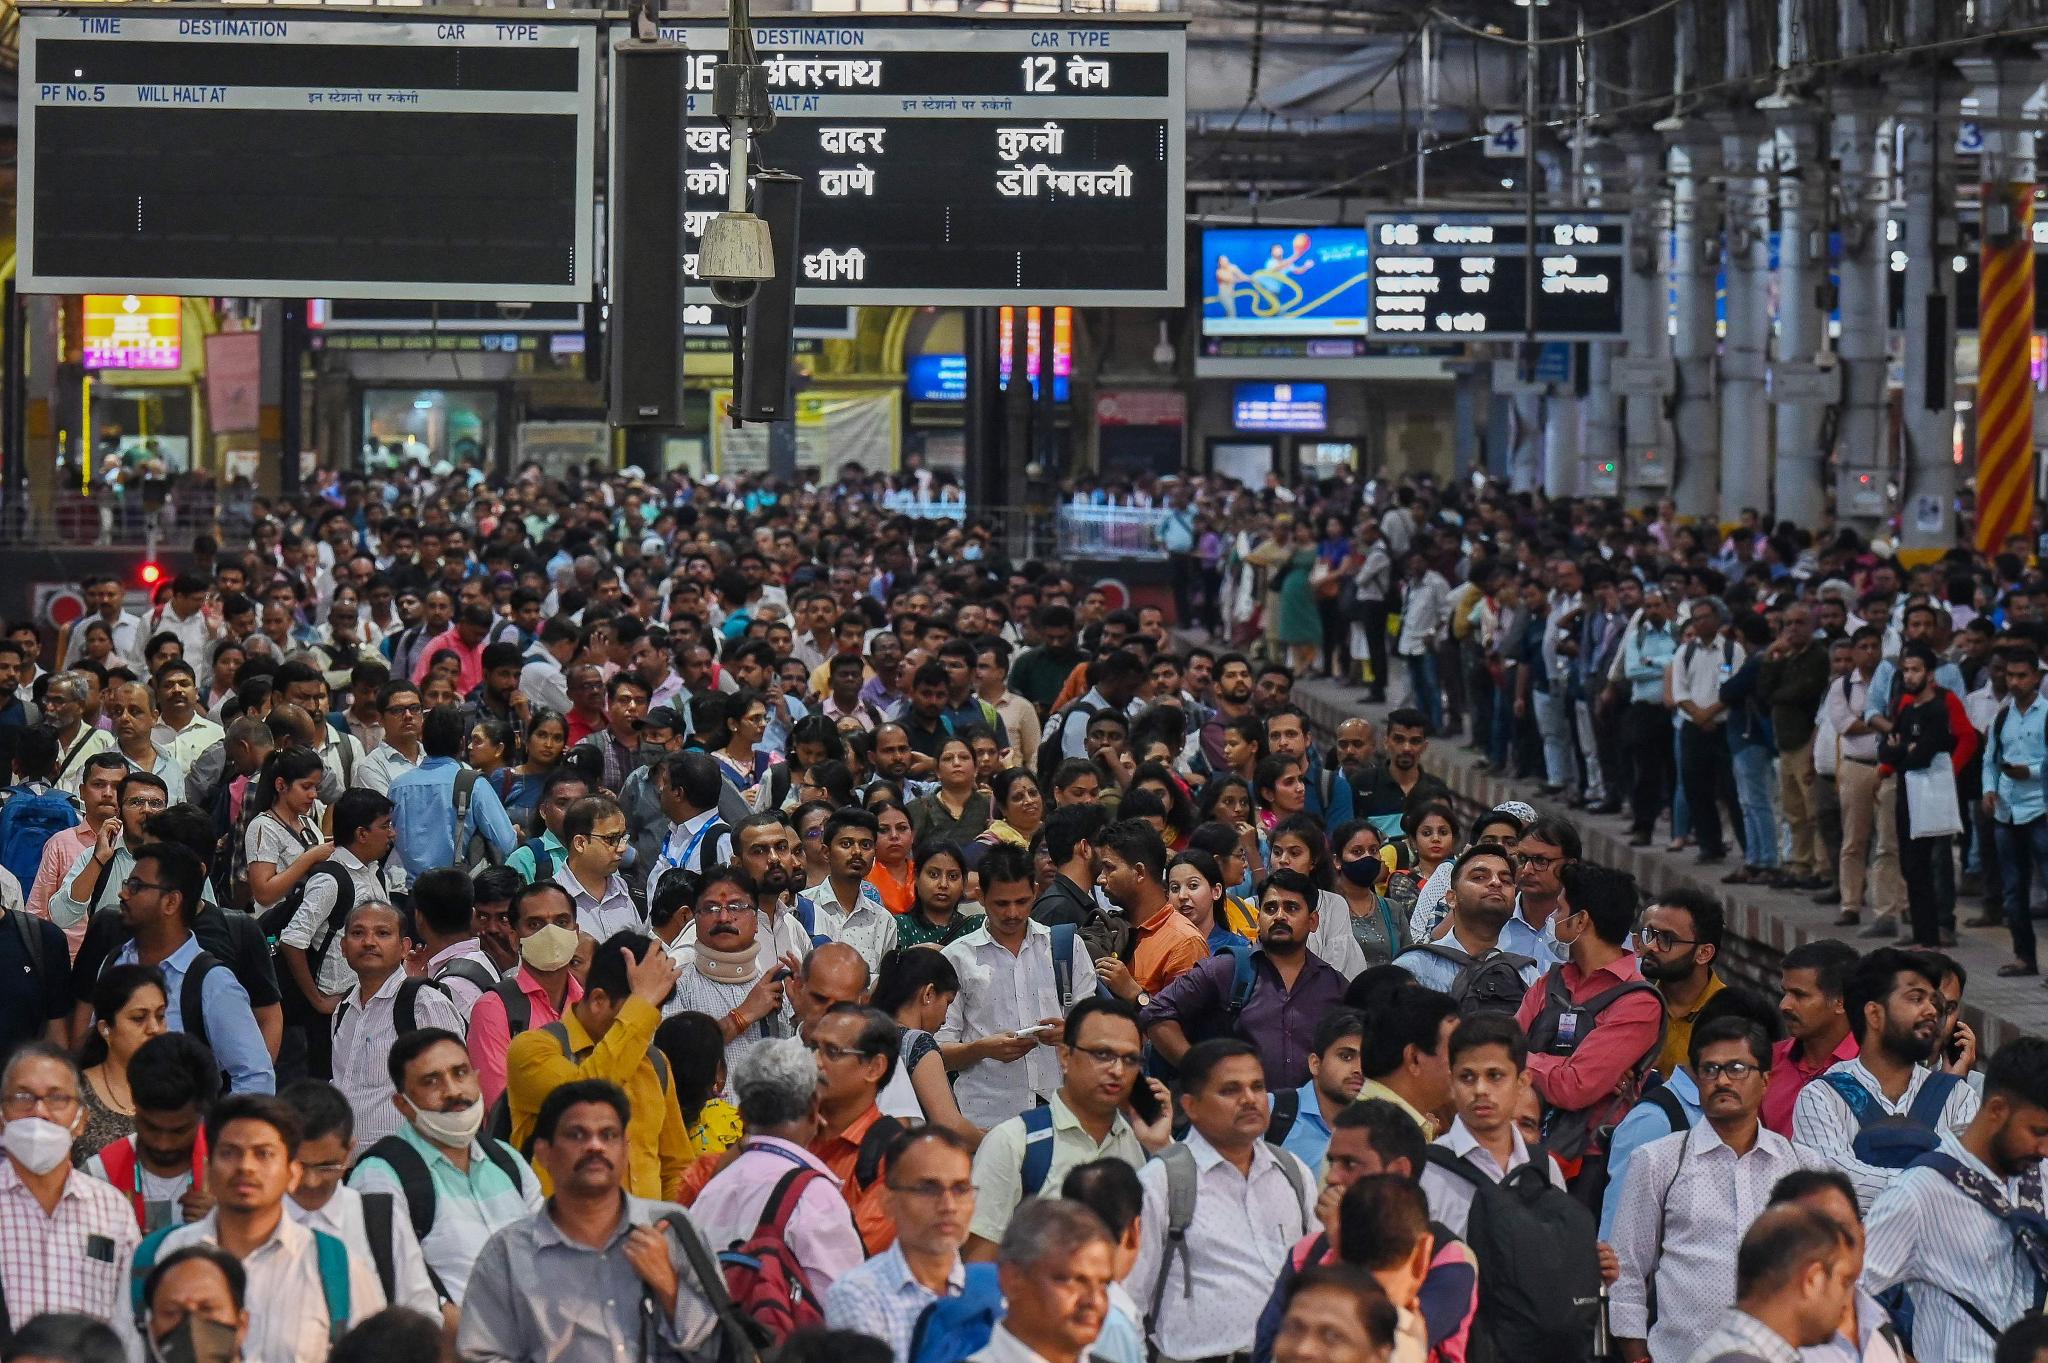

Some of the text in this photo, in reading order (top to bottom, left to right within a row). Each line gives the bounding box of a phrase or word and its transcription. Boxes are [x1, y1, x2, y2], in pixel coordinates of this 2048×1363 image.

[80, 17, 539, 41] TIME DESTINATION CAR TYPE
[757, 30, 865, 45] DESTINATION
[1031, 32, 1060, 47] CAR
[1068, 31, 1111, 47] TYPE
[1021, 56, 1057, 92] 12
[1066, 54, 1110, 88] तेज
[41, 85, 61, 101] PF
[137, 86, 171, 103] WILL
[173, 87, 208, 103] HALT
[210, 88, 227, 103] AT
[368, 93, 382, 104] पर
[803, 96, 820, 111] AT
[962, 100, 977, 111] पर
[819, 127, 887, 153] दादर
[1493, 122, 1518, 152] 4
[1962, 123, 1984, 149] 3
[819, 163, 876, 196] ठाणे
[803, 248, 866, 281] धीमी
